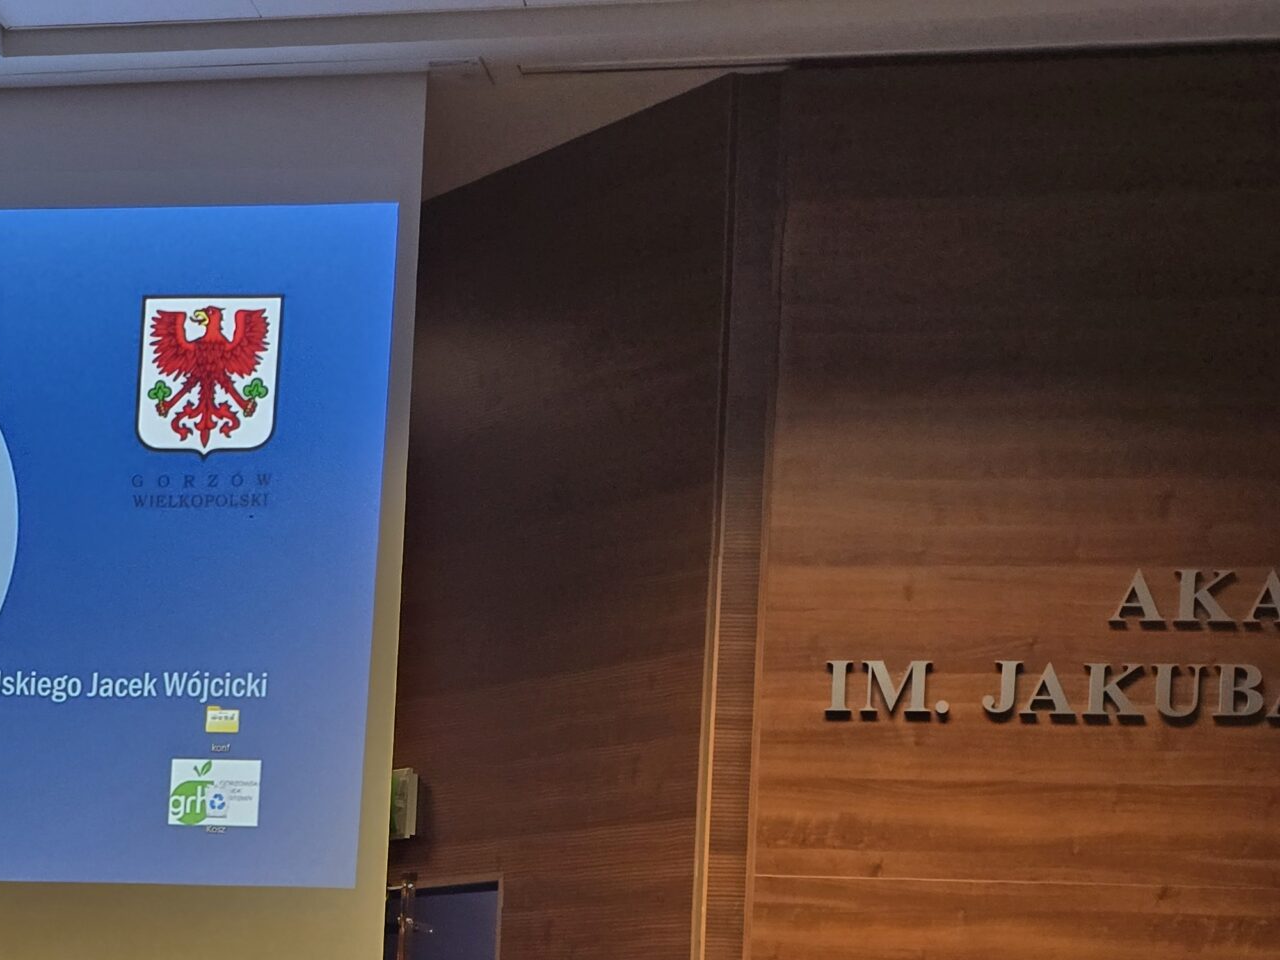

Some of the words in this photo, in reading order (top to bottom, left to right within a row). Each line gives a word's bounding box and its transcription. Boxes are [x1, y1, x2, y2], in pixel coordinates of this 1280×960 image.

[132, 493, 269, 509] WIELKOPOLSKI
[1107, 567, 1280, 623] AKA
[87, 672, 158, 698] Jacek
[163, 670, 269, 703] Wójcicki
[824, 660, 950, 716] IM.
[982, 660, 1280, 719] JAKUB
